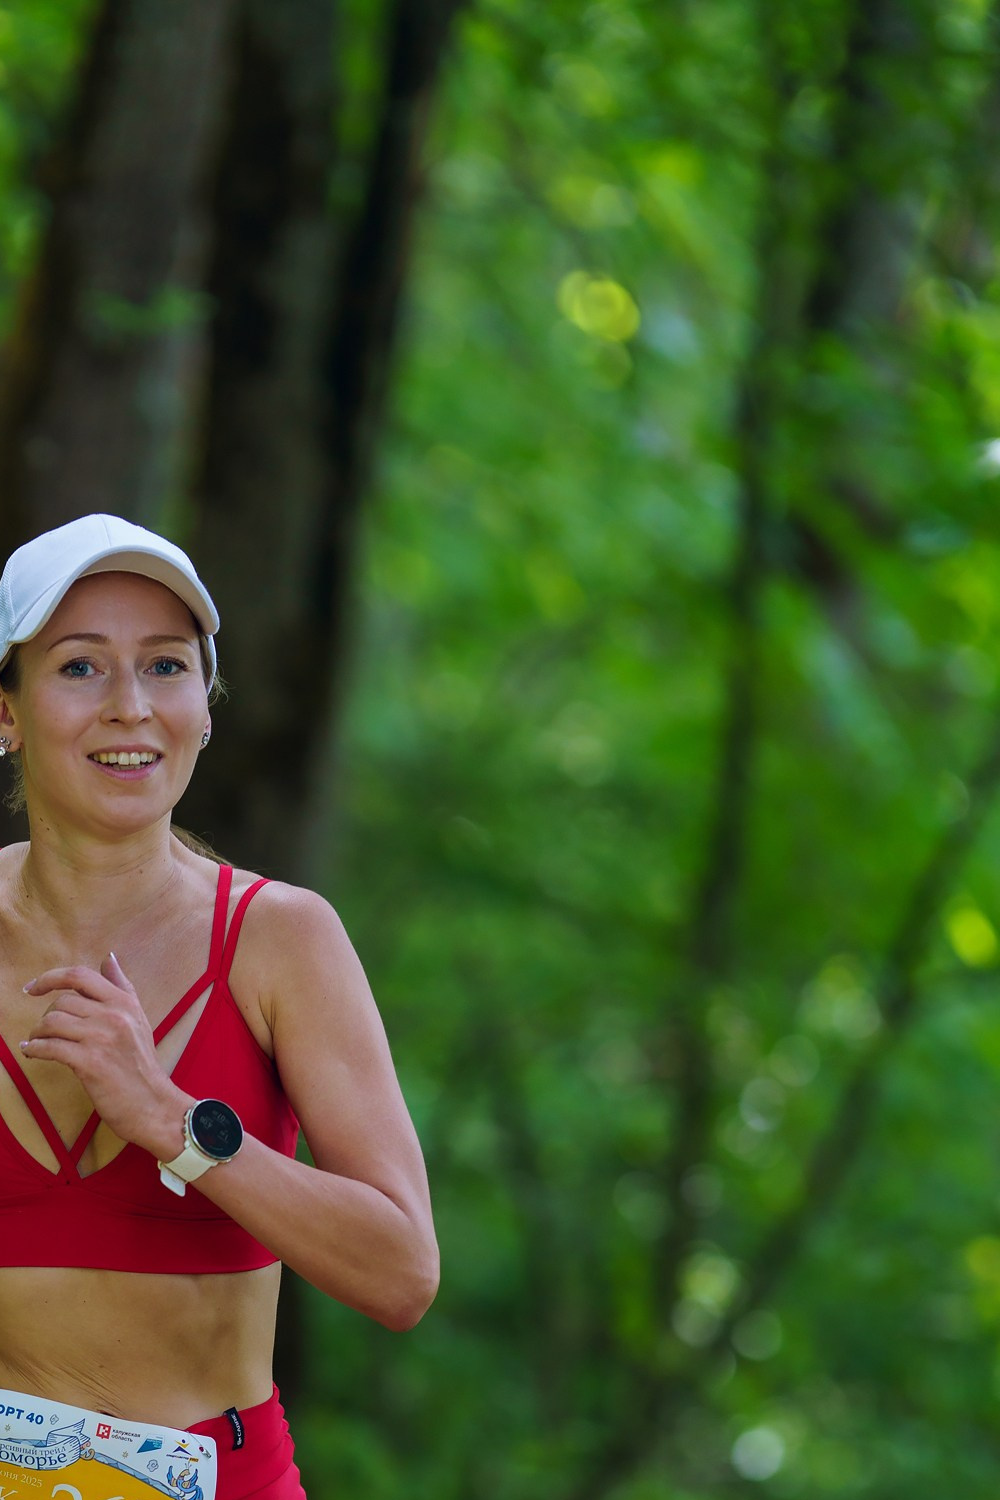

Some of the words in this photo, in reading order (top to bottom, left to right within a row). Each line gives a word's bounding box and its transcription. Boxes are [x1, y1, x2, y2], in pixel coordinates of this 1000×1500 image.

[25, 1412, 44, 1425] 40
[40, 1446, 66, 1458] трейл
[20, 1473, 43, 1488] 2025
